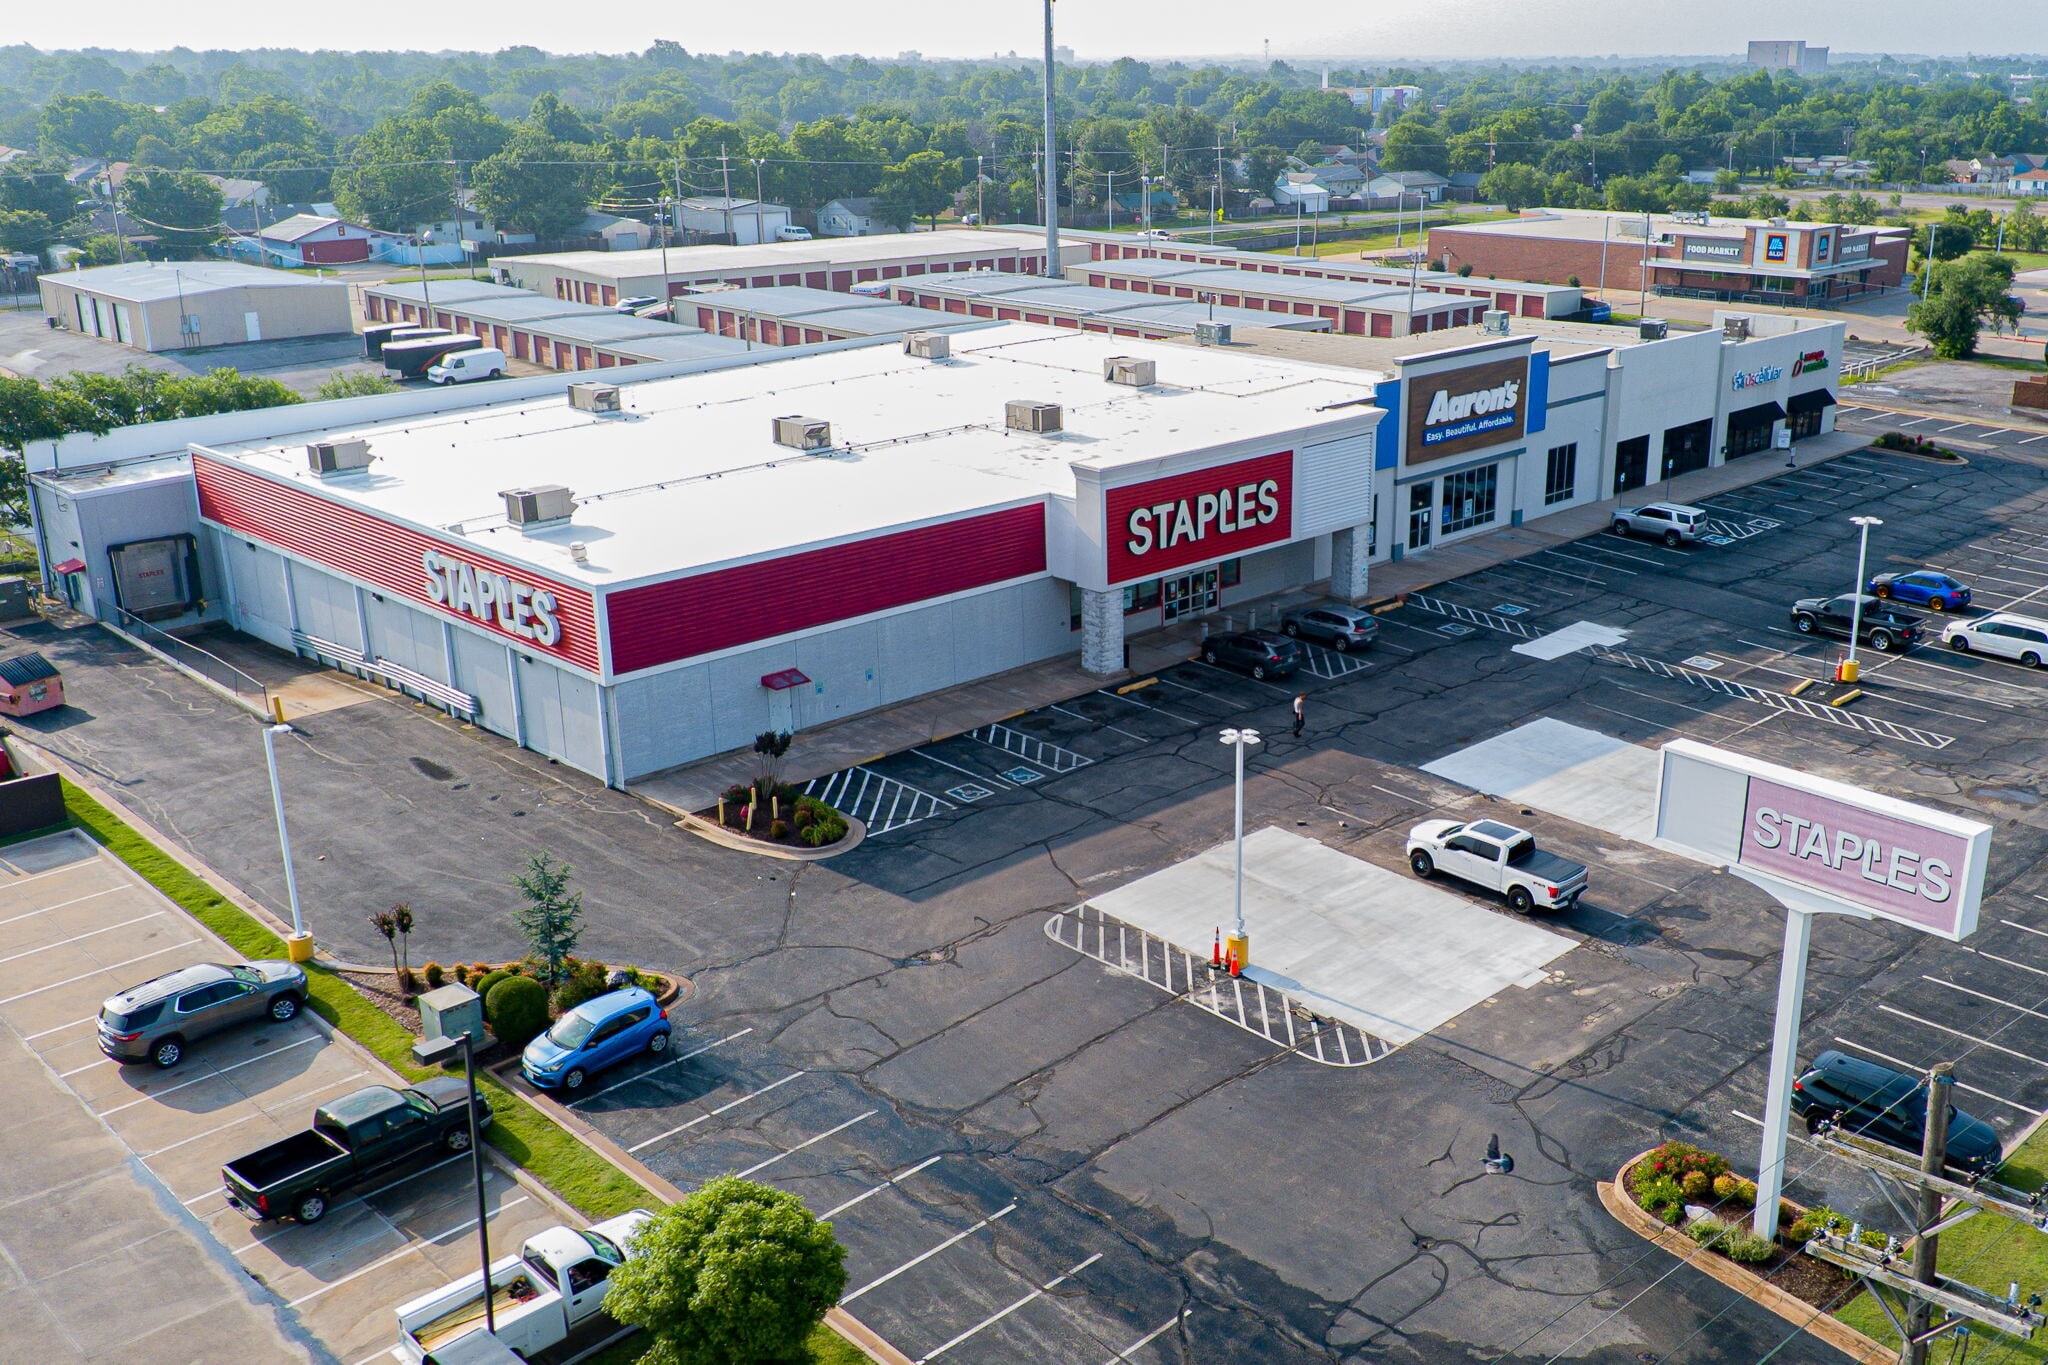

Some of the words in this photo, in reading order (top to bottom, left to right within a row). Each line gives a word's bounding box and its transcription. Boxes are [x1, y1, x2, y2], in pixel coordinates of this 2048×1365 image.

[1687, 245, 1706, 254] FOOD
[1707, 246, 1740, 256] MARKET
[1425, 380, 1520, 426] Aaron's
[1426, 432, 1444, 442] Easy.
[1445, 423, 1477, 438] Beautiful.
[1478, 415, 1514, 430] Affordable.
[1127, 479, 1279, 556] STAPLES
[422, 548, 561, 647] STAPLES
[1752, 806, 1953, 903] STAPLES
